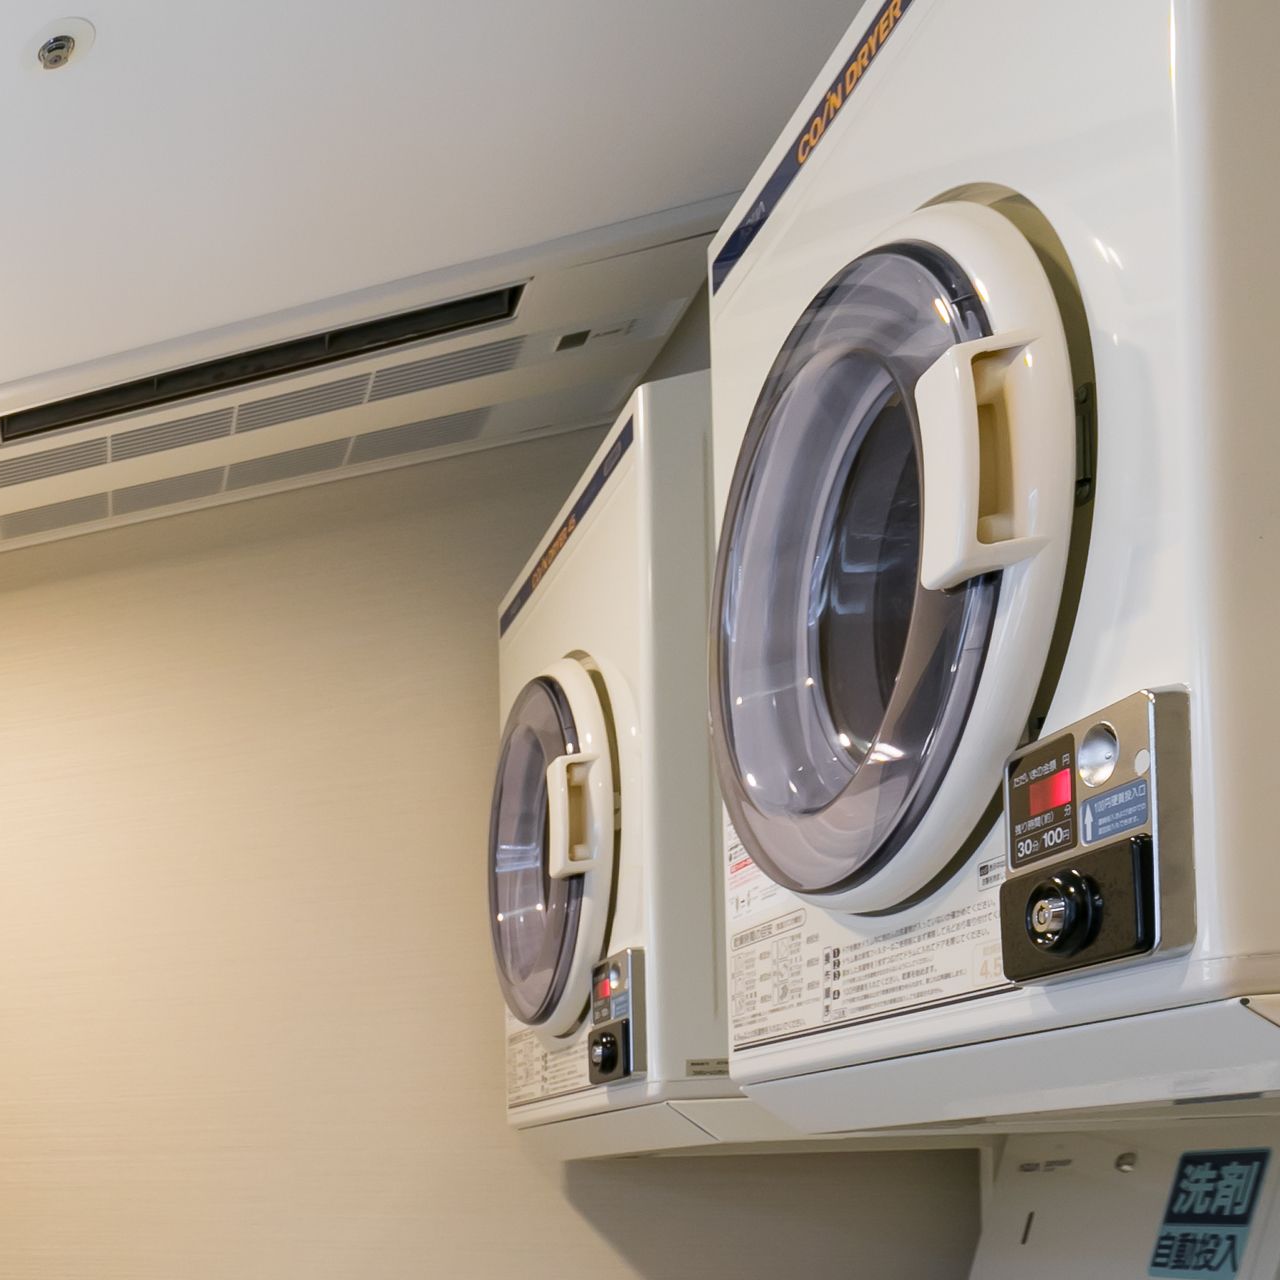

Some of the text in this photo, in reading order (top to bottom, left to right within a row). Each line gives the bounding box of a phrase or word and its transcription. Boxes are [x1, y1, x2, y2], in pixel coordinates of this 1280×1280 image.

[844, 0, 902, 95] DRYER
[1173, 1161, 1258, 1216] 洗剤
[1153, 1233, 1238, 1273] 自動投入
